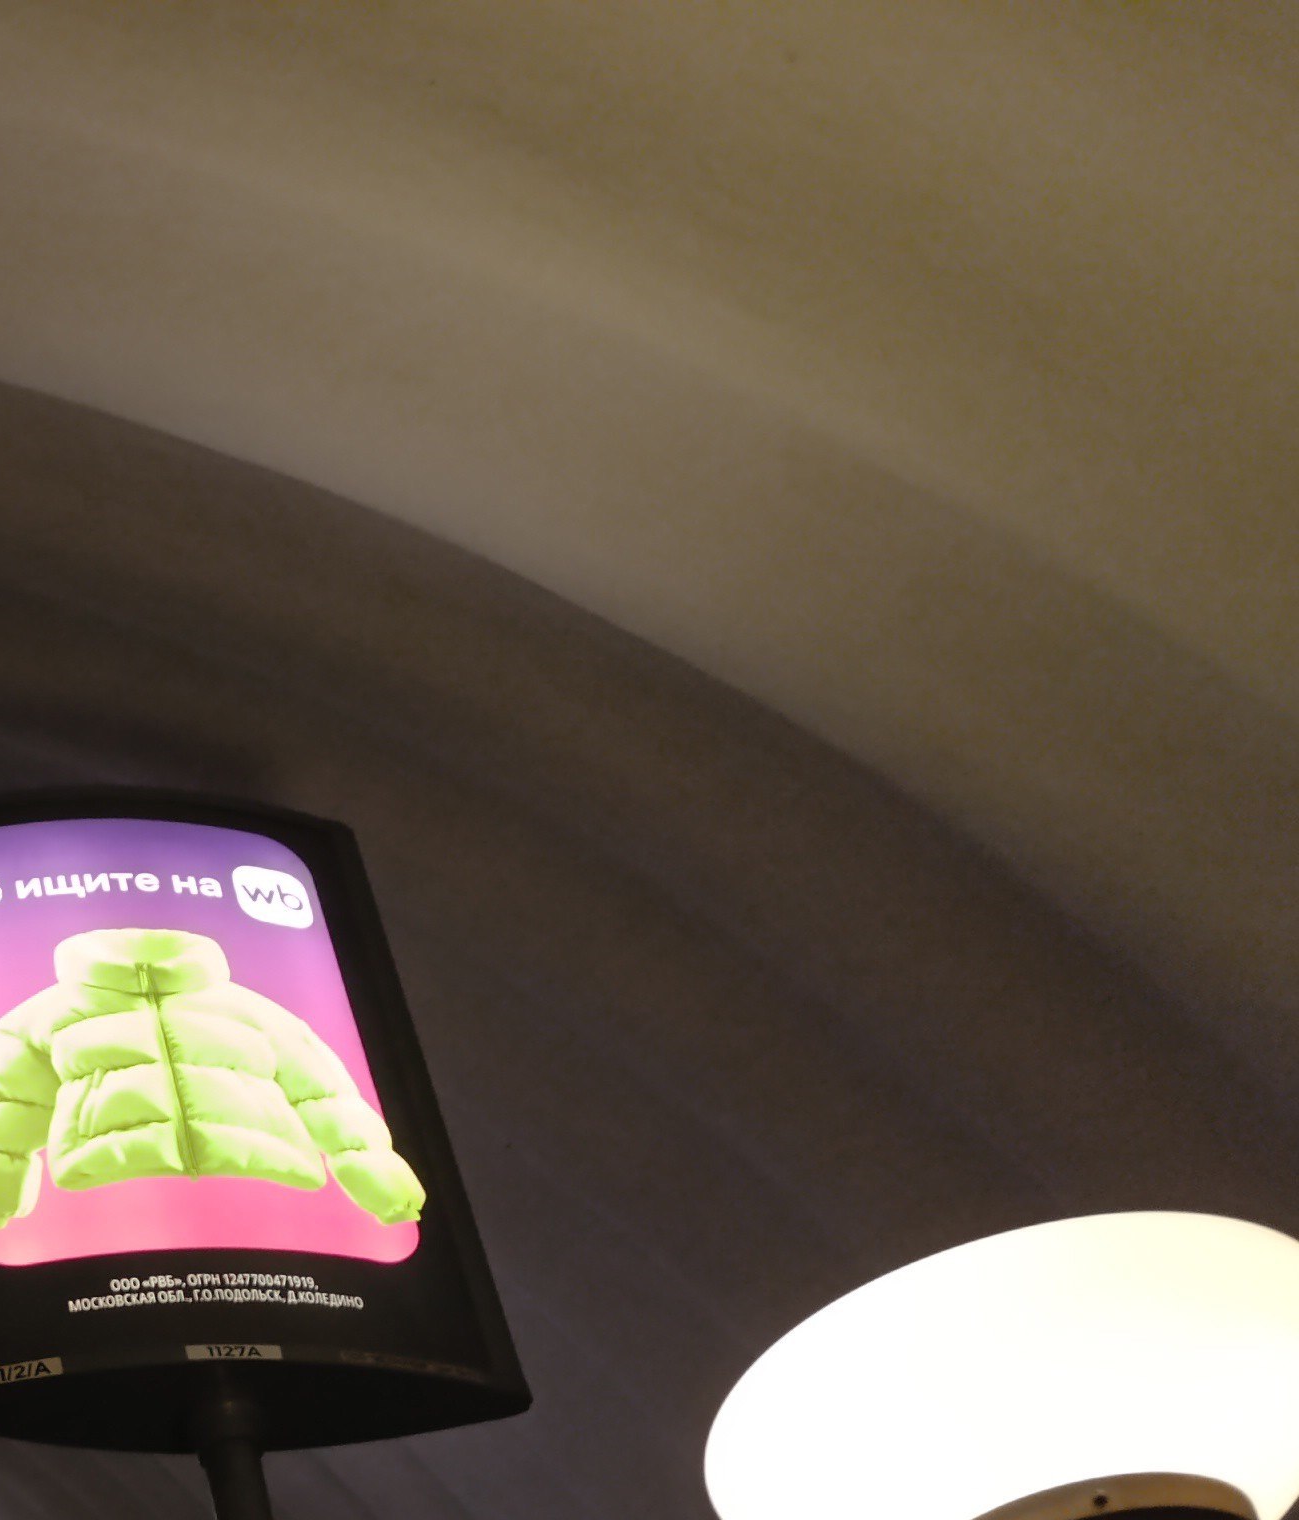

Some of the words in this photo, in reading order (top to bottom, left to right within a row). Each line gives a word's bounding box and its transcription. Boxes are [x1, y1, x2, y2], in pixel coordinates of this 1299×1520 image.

[15, 871, 160, 900] ищите
[173, 873, 223, 899] на
[109, 1277, 141, 1292] ООО
[187, 1273, 221, 1288] ОГРН
[223, 1273, 318, 1290] 1247700471919,
[67, 1291, 156, 1313] МОСКОВСКАЯ
